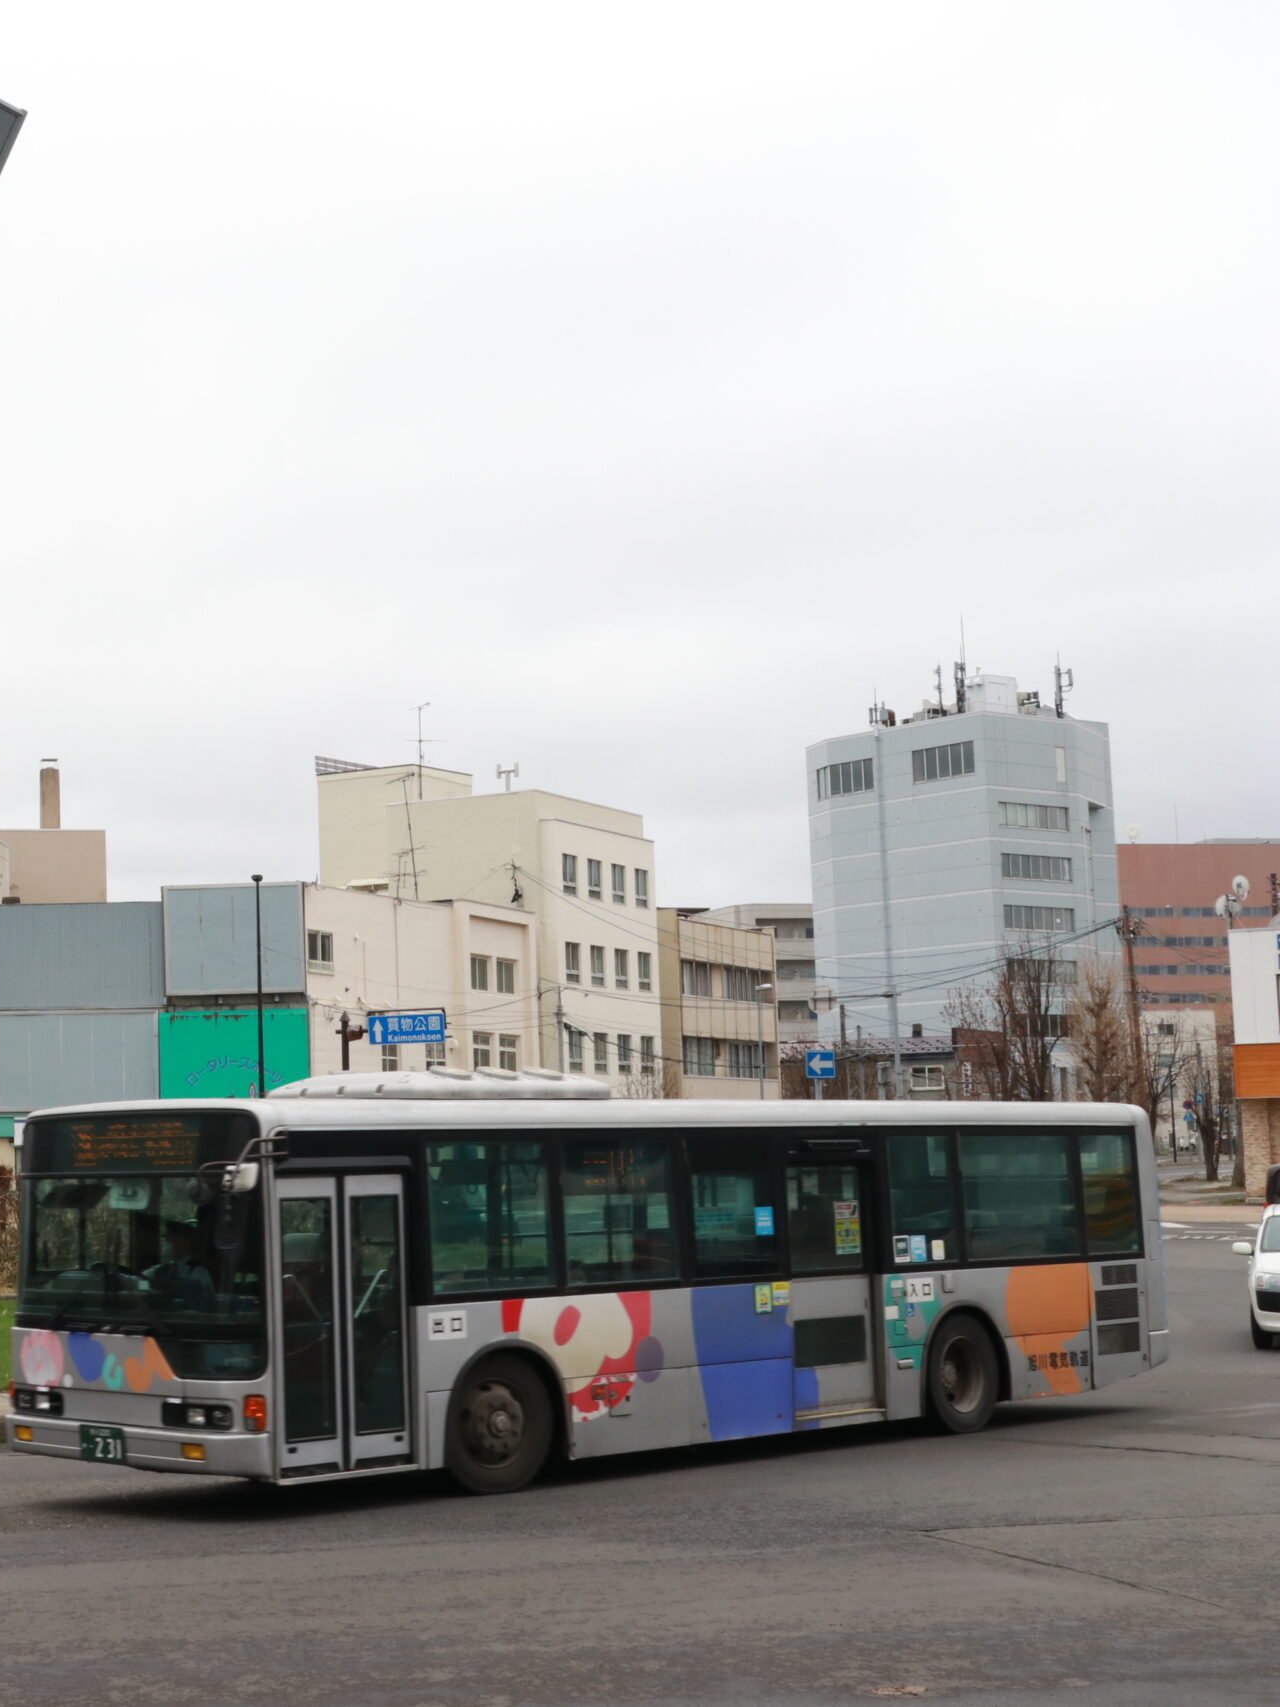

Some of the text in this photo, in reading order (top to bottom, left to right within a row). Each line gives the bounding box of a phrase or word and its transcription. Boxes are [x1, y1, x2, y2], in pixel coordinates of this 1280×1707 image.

[387, 1016, 441, 1032] 買物公園
[388, 1033, 442, 1042] Kaimonokoen
[910, 1283, 932, 1298] 入口
